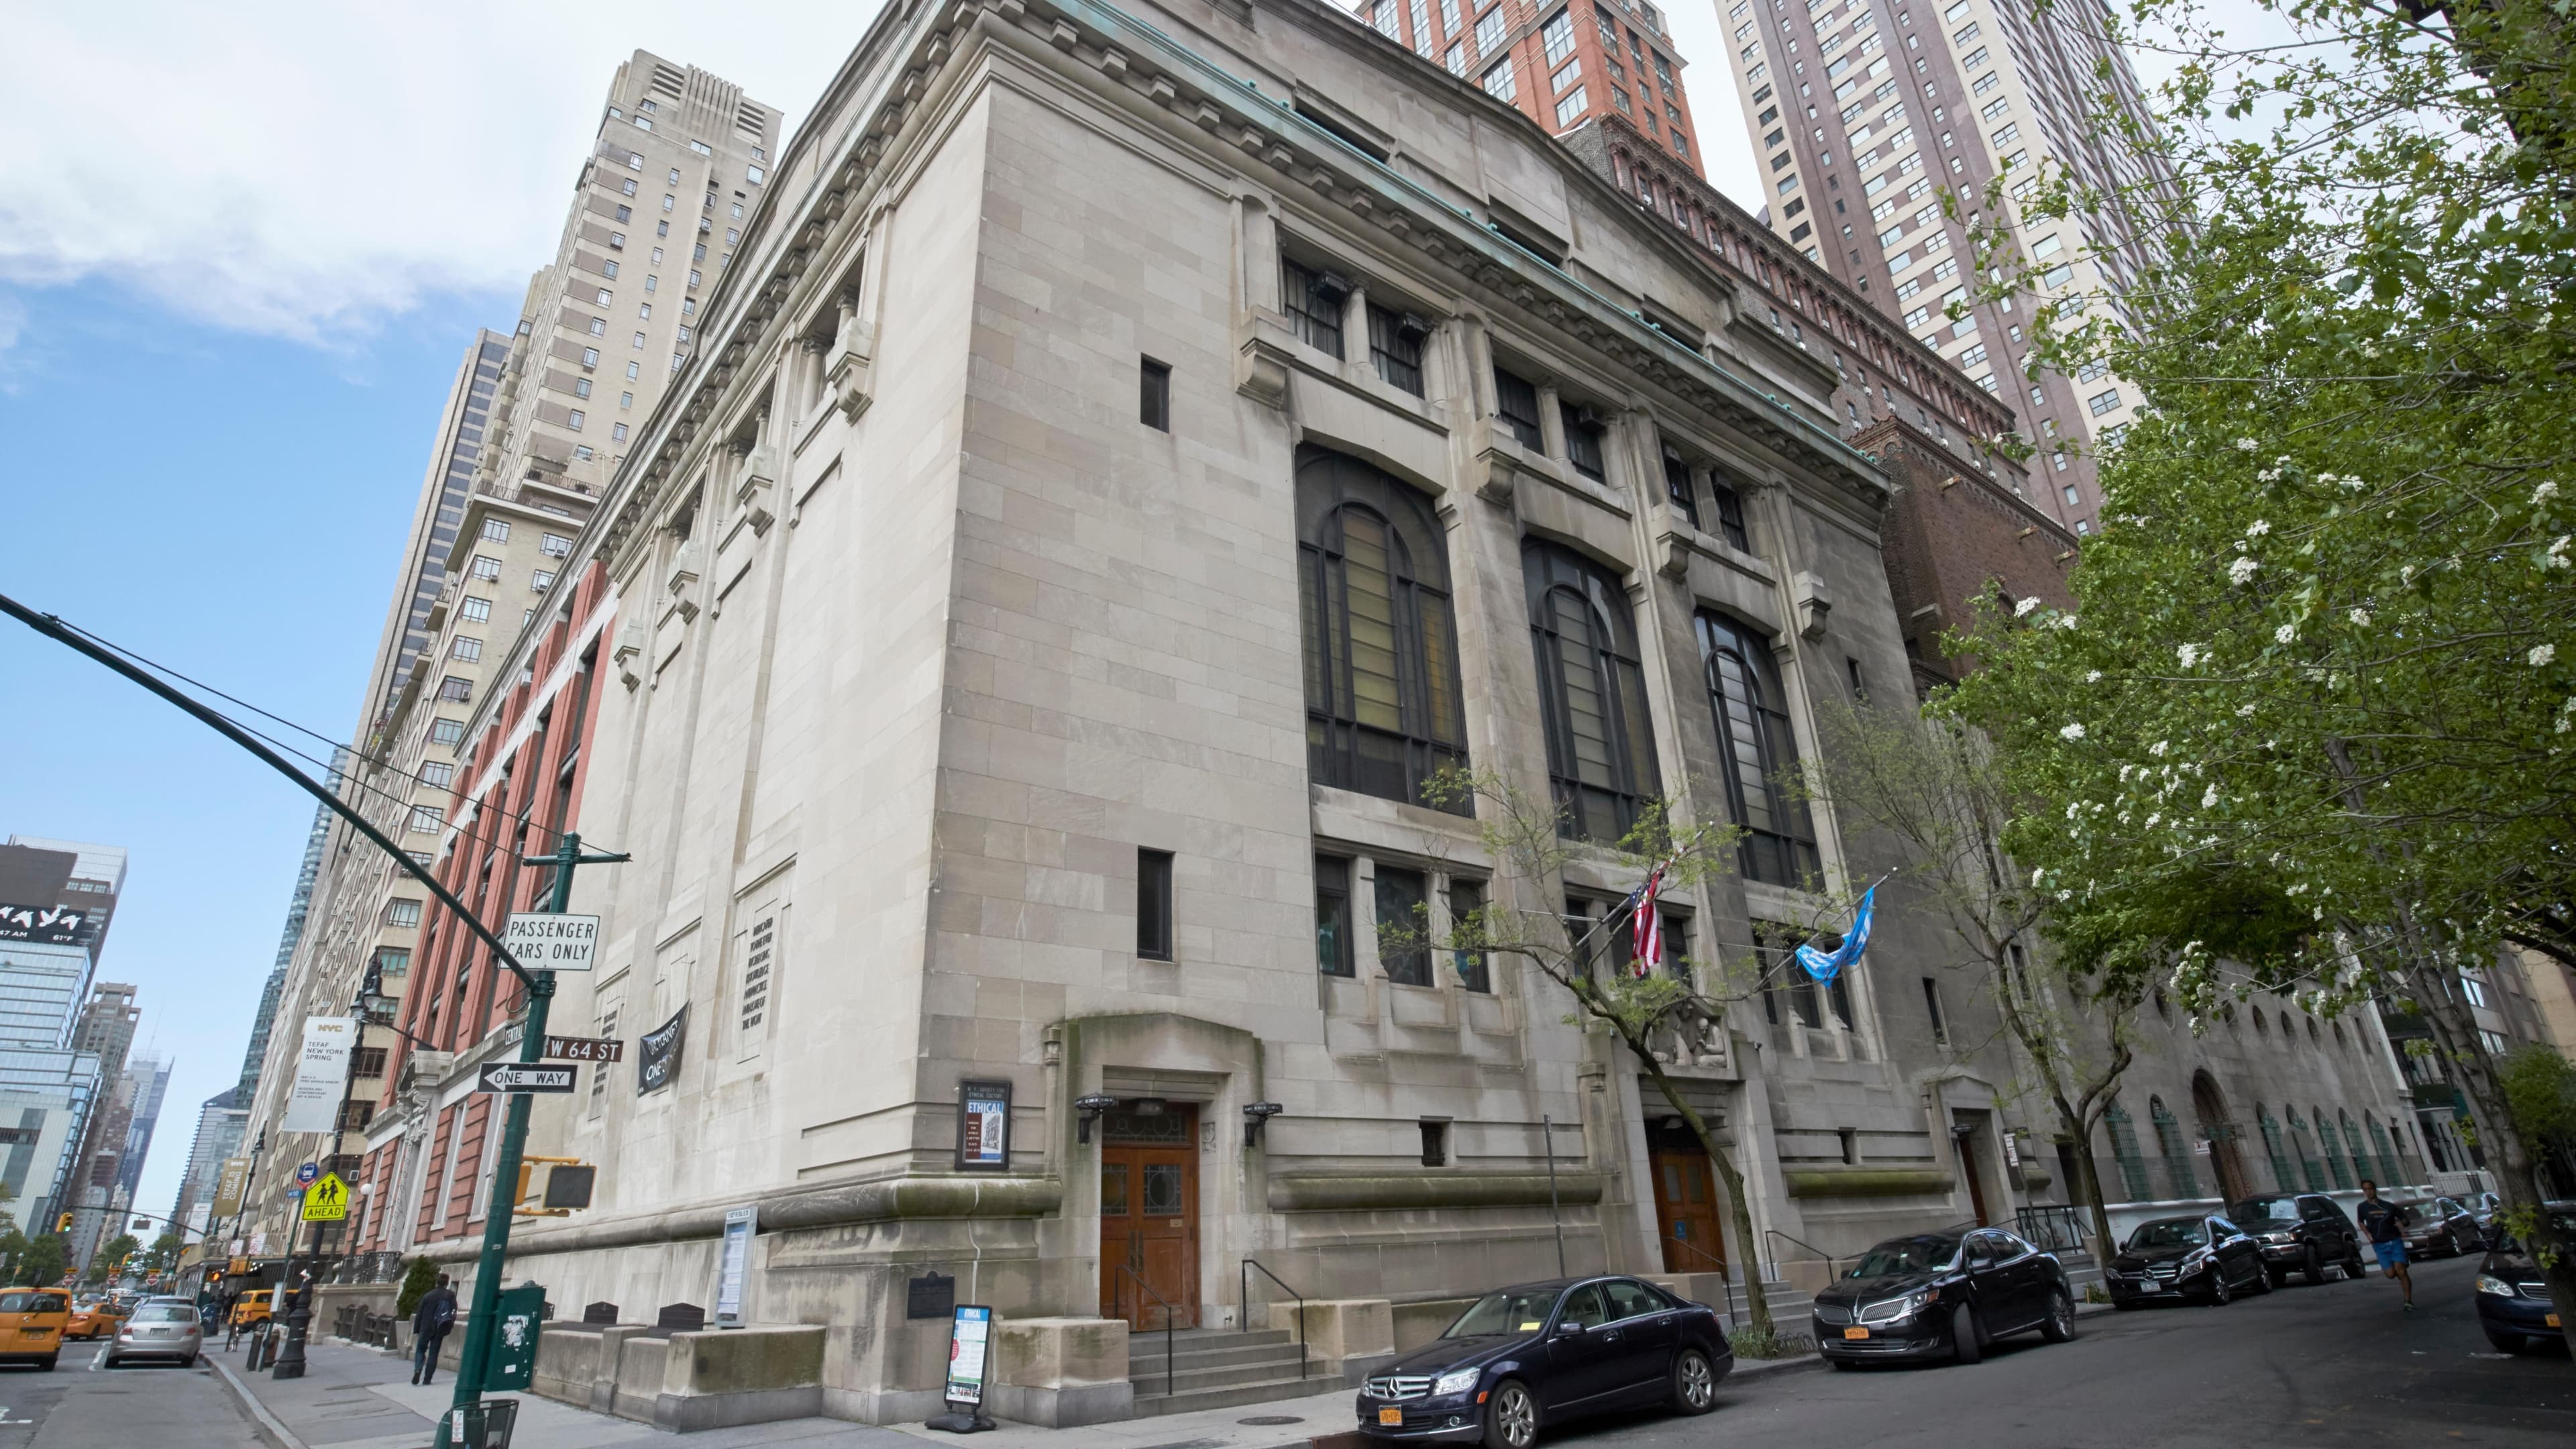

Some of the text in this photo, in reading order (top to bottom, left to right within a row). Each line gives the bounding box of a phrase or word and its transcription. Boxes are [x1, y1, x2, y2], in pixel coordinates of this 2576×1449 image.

[510, 921, 594, 938] PASSENGER
[507, 943, 590, 960] CARS ONLY
[317, 1024, 343, 1032] NYC
[505, 1024, 523, 1046] CENTRAL
[551, 1040, 564, 1057] W
[569, 1042, 591, 1059] 64
[598, 1043, 619, 1060] ST
[494, 1072, 565, 1084] ONE WAY
[967, 1102, 1002, 1114] ETHICAL
[222, 1179, 232, 1199] TEFAF
[229, 1171, 242, 1200] COMING
[307, 1207, 341, 1218] AHEAD
[965, 1309, 981, 1319] ETHICAL
